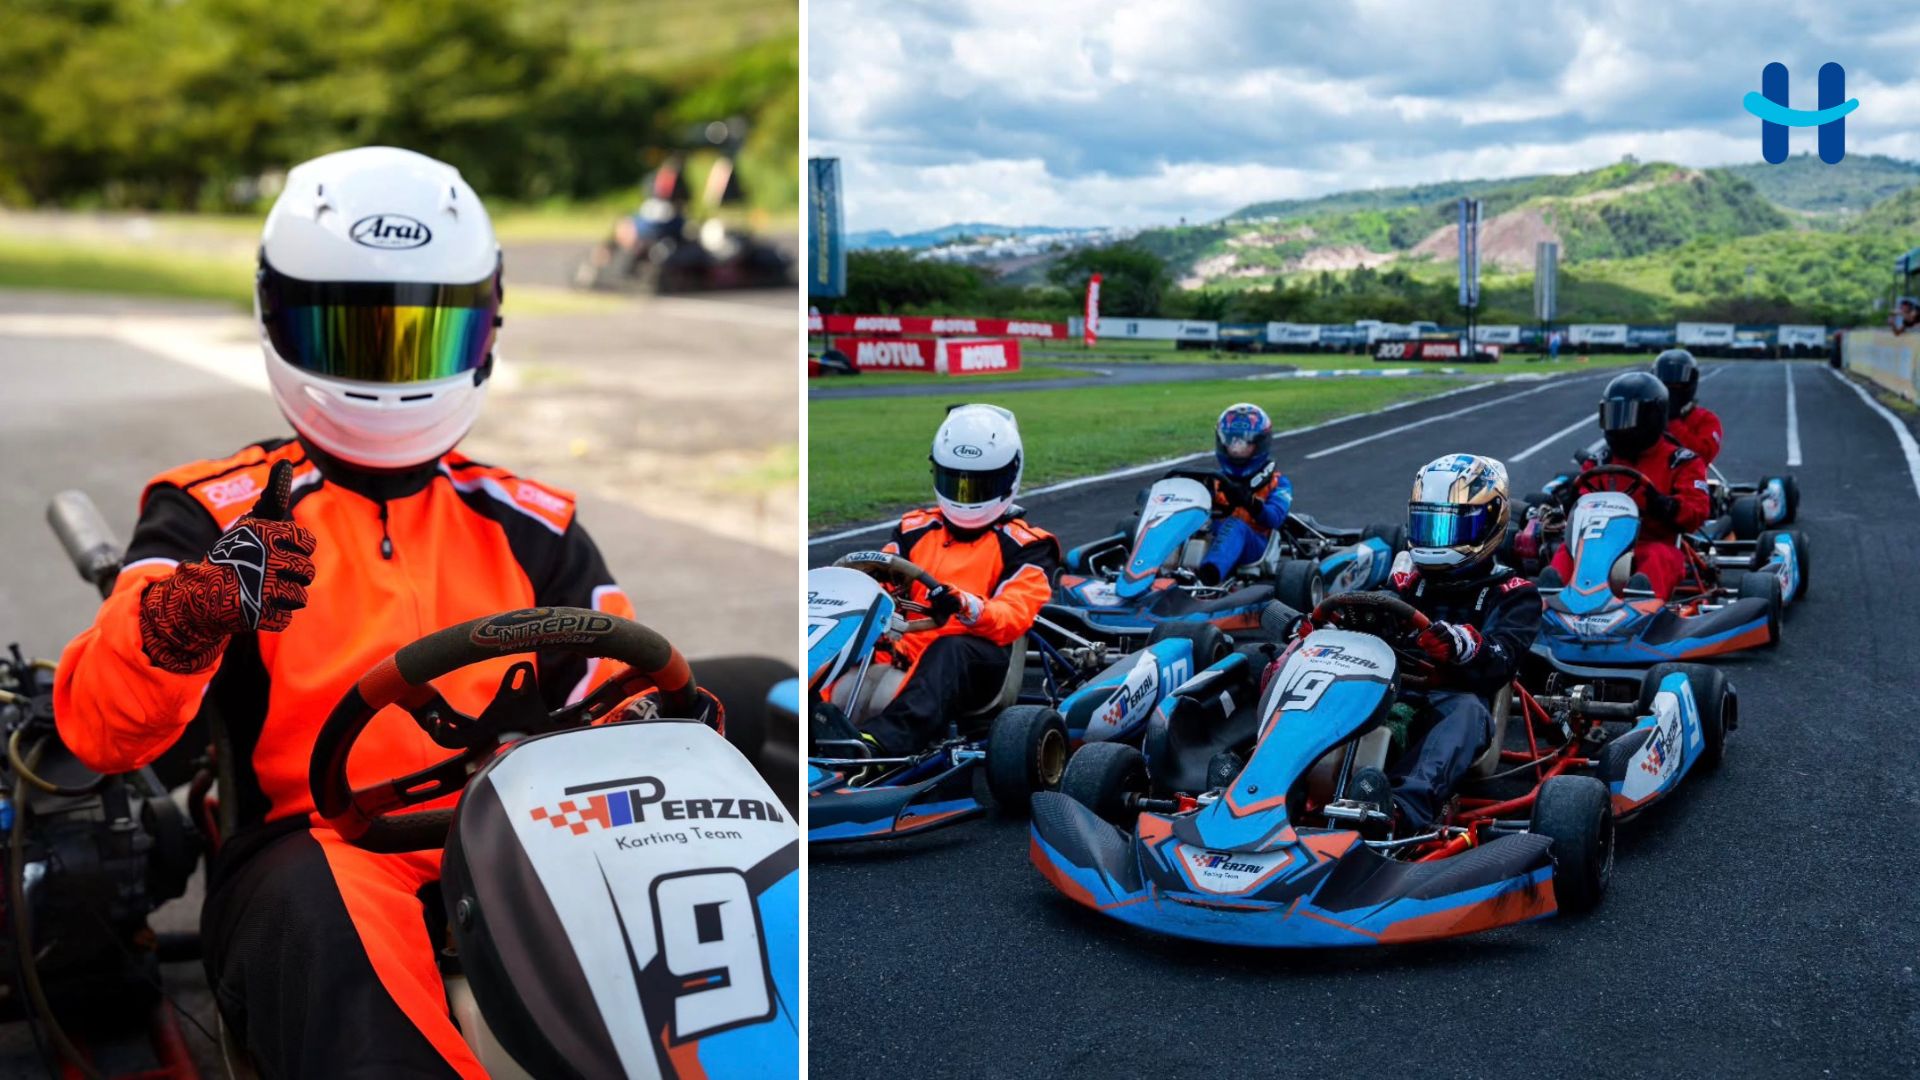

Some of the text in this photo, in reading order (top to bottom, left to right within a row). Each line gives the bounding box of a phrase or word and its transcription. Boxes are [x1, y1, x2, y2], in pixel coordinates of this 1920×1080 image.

[355, 216, 421, 240] Arai
[854, 317, 902, 331] MOTUL
[931, 319, 977, 333] MOTUL
[1007, 322, 1053, 336] MOTUL
[856, 342, 925, 366] MOTUL
[960, 345, 1007, 370] MOTUL
[498, 615, 614, 643] INTREPID
[1315, 644, 1379, 670] PERZAV
[1109, 673, 1153, 708] PERZAV
[1280, 669, 1337, 712] 9
[615, 826, 743, 850] Karting Team
[1206, 851, 1264, 874] PERZAV
[653, 869, 774, 1042] 9
